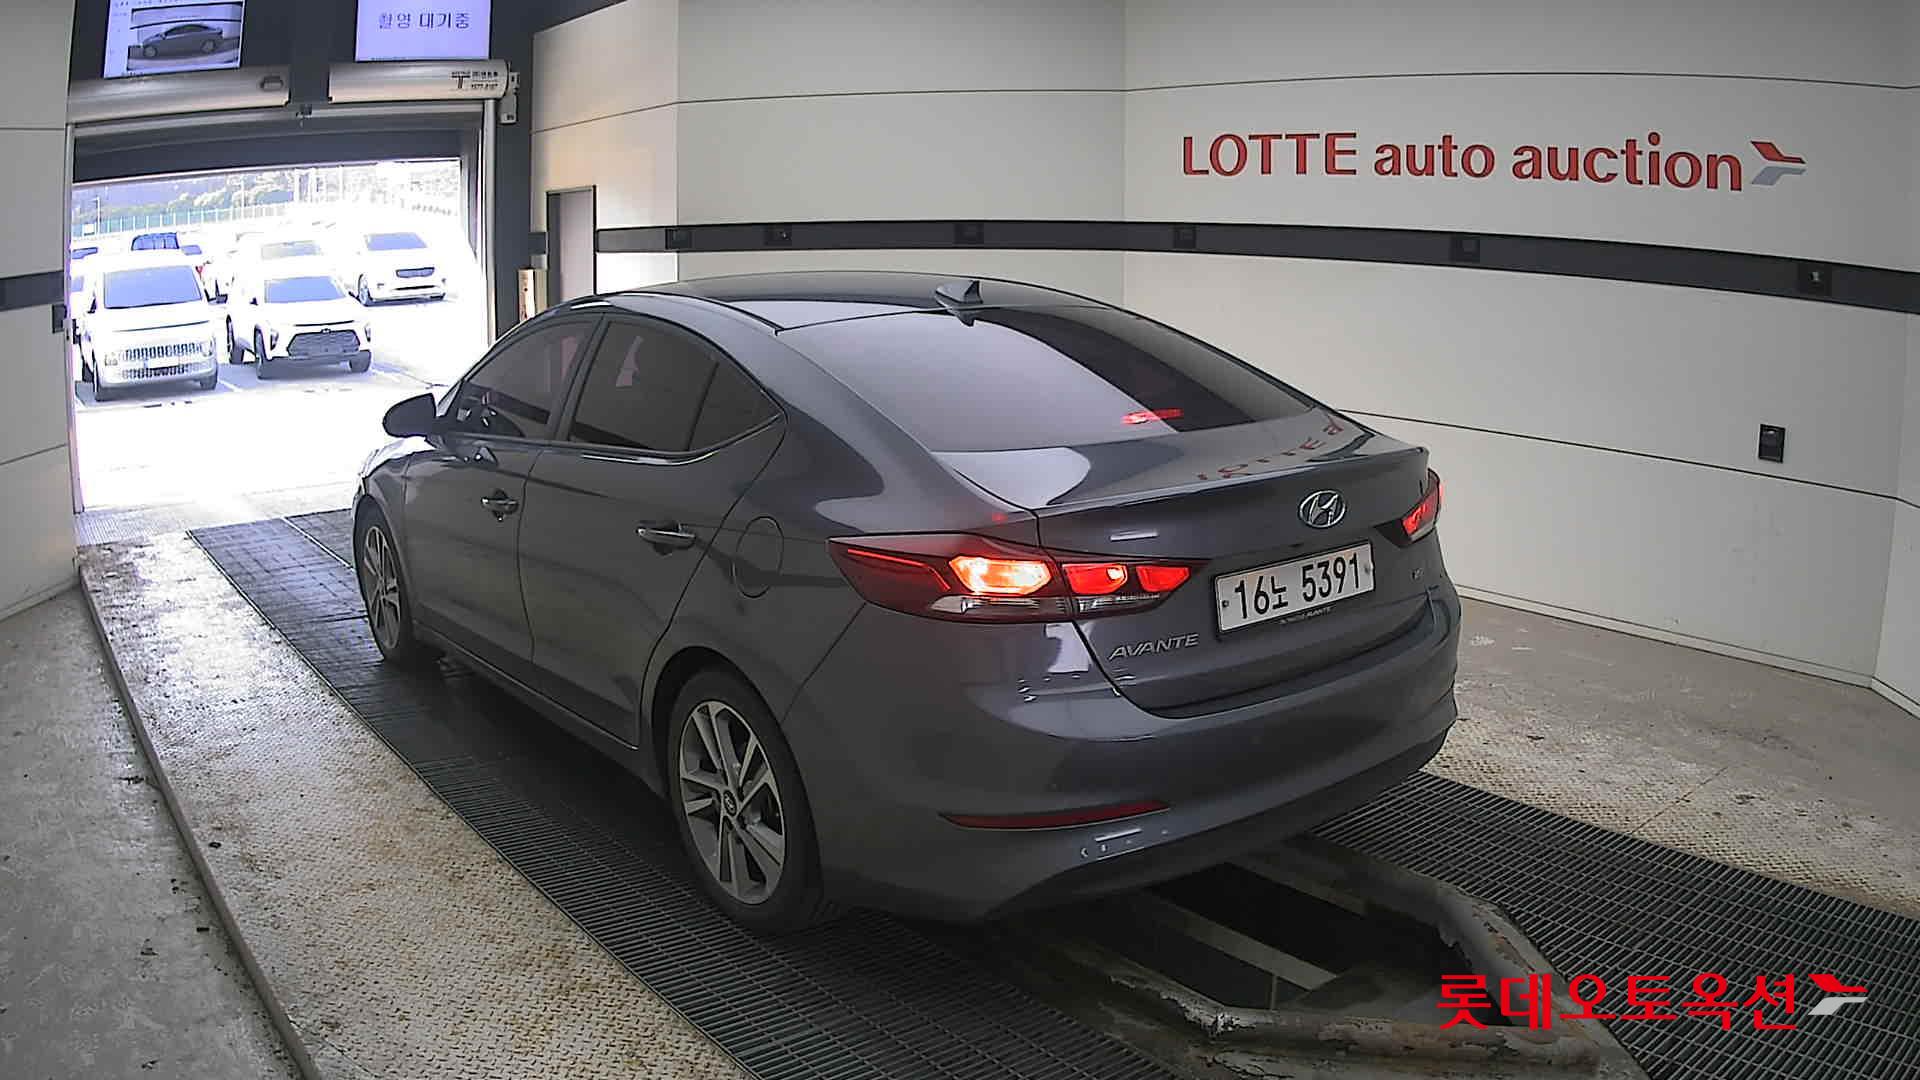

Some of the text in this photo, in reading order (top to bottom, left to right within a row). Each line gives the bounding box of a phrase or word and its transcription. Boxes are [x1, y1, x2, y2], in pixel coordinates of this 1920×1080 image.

[1183, 131, 1742, 192] LOTTE auto auction
[1234, 552, 1359, 619] 16노 5391
[1108, 633, 1199, 660] AVANTE
